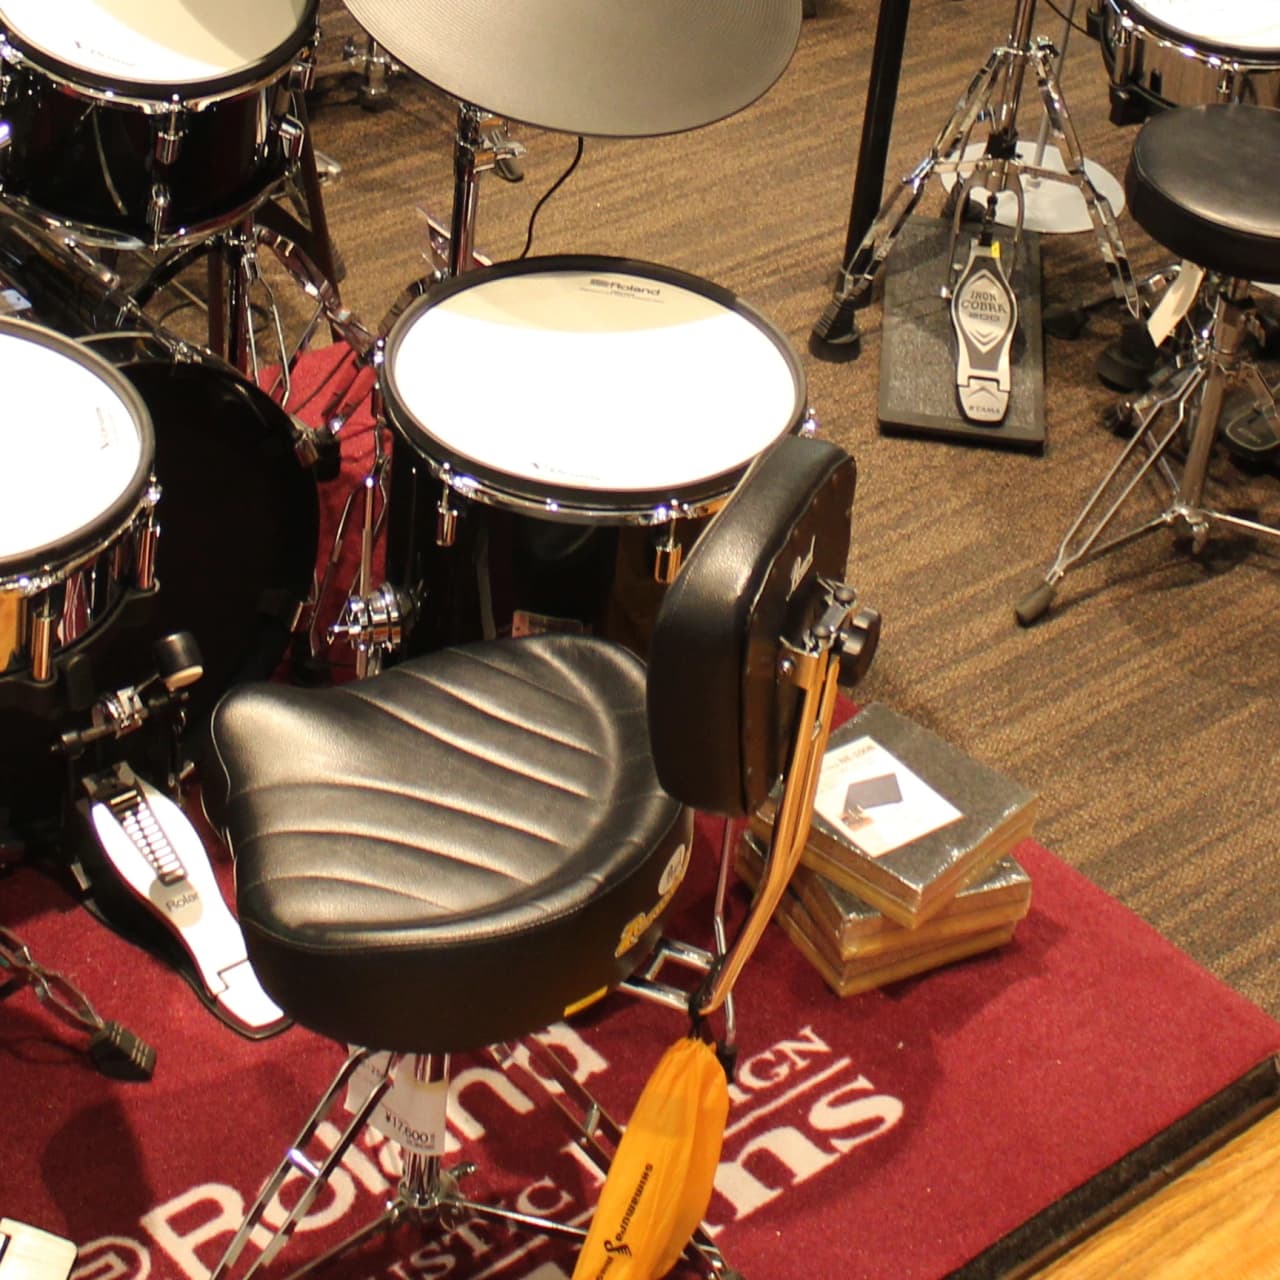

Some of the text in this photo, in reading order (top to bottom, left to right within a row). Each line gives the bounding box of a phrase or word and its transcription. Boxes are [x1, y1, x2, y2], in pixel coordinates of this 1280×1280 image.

[611, 281, 660, 296] Roland
[970, 291, 996, 300] IRON
[961, 300, 1007, 314] COBRA
[974, 407, 1000, 415] TAMA
[385, 1111, 431, 1144] ¥17,600
[140, 1020, 610, 1280] Rolnd
